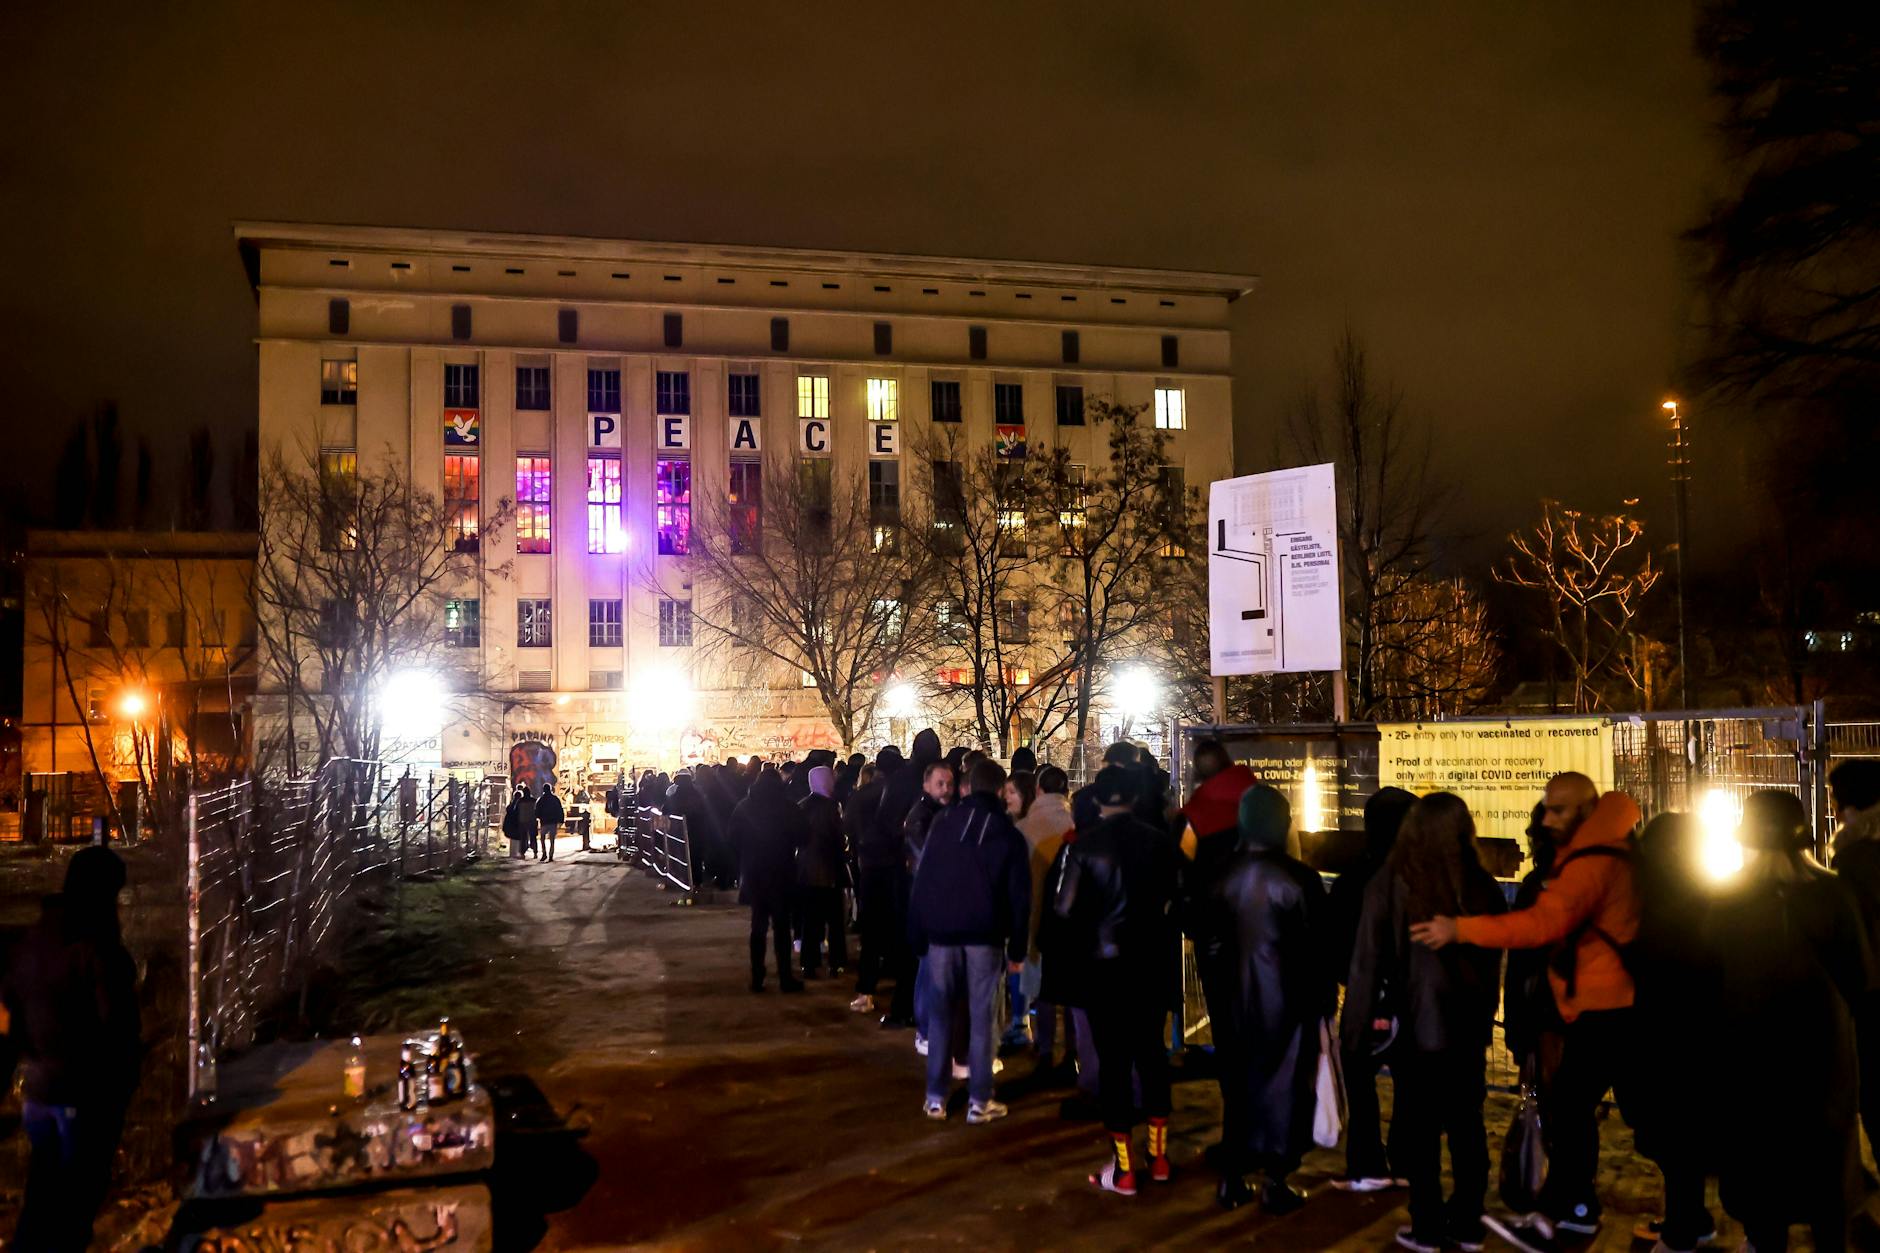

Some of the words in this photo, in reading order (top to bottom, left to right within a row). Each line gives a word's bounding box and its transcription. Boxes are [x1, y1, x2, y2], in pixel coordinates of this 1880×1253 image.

[1414, 731, 1435, 742] entry
[1440, 731, 1458, 741] only
[1462, 730, 1474, 739] for
[1478, 729, 1531, 738] vaccinated
[1535, 729, 1544, 738] or
[1548, 727, 1599, 737] recovered
[1250, 759, 1283, 768] Impfung
[1285, 759, 1304, 768] oder
[1396, 758, 1420, 767] Proof
[1424, 757, 1433, 766] of
[1436, 757, 1488, 766] vaccination
[1491, 758, 1502, 766] or
[1504, 757, 1544, 767] recovery
[1396, 771, 1415, 782] only
[1418, 771, 1438, 780] with
[1448, 770, 1478, 781] digital
[1481, 770, 1512, 780] COVID
